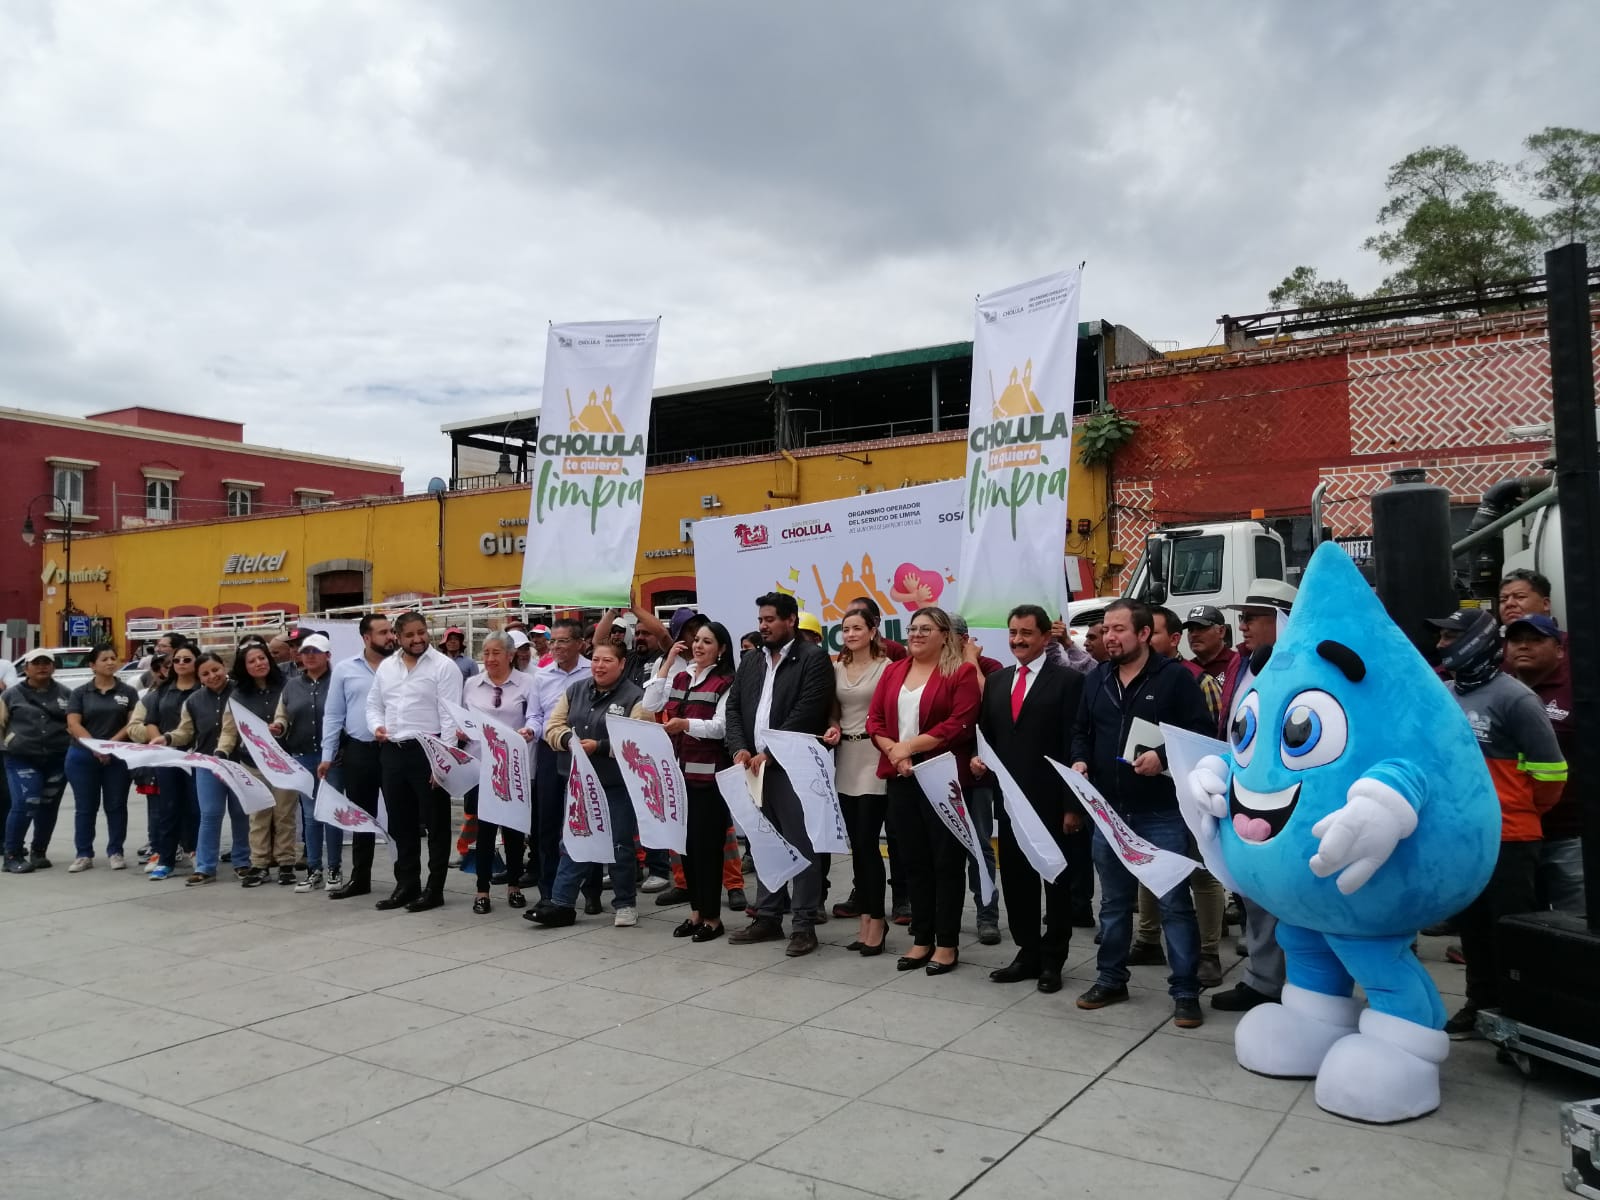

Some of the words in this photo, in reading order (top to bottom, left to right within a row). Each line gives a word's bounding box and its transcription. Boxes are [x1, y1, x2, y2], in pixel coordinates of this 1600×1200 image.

[970, 412, 1068, 453] CHOLULA
[539, 434, 644, 456] CHOLULA
[565, 459, 579, 469] te
[580, 458, 620, 472] quiero
[1000, 446, 1038, 467] quiero
[537, 460, 643, 535] limpia
[701, 494, 721, 510] EL
[968, 455, 1067, 541] limpia
[847, 507, 885, 518] ORGANISMO
[886, 502, 921, 513] OPERADOR
[861, 514, 889, 525] SERVICIO
[890, 512, 899, 520] DE
[782, 523, 832, 539] CHOLULA
[236, 550, 288, 574] telcel
